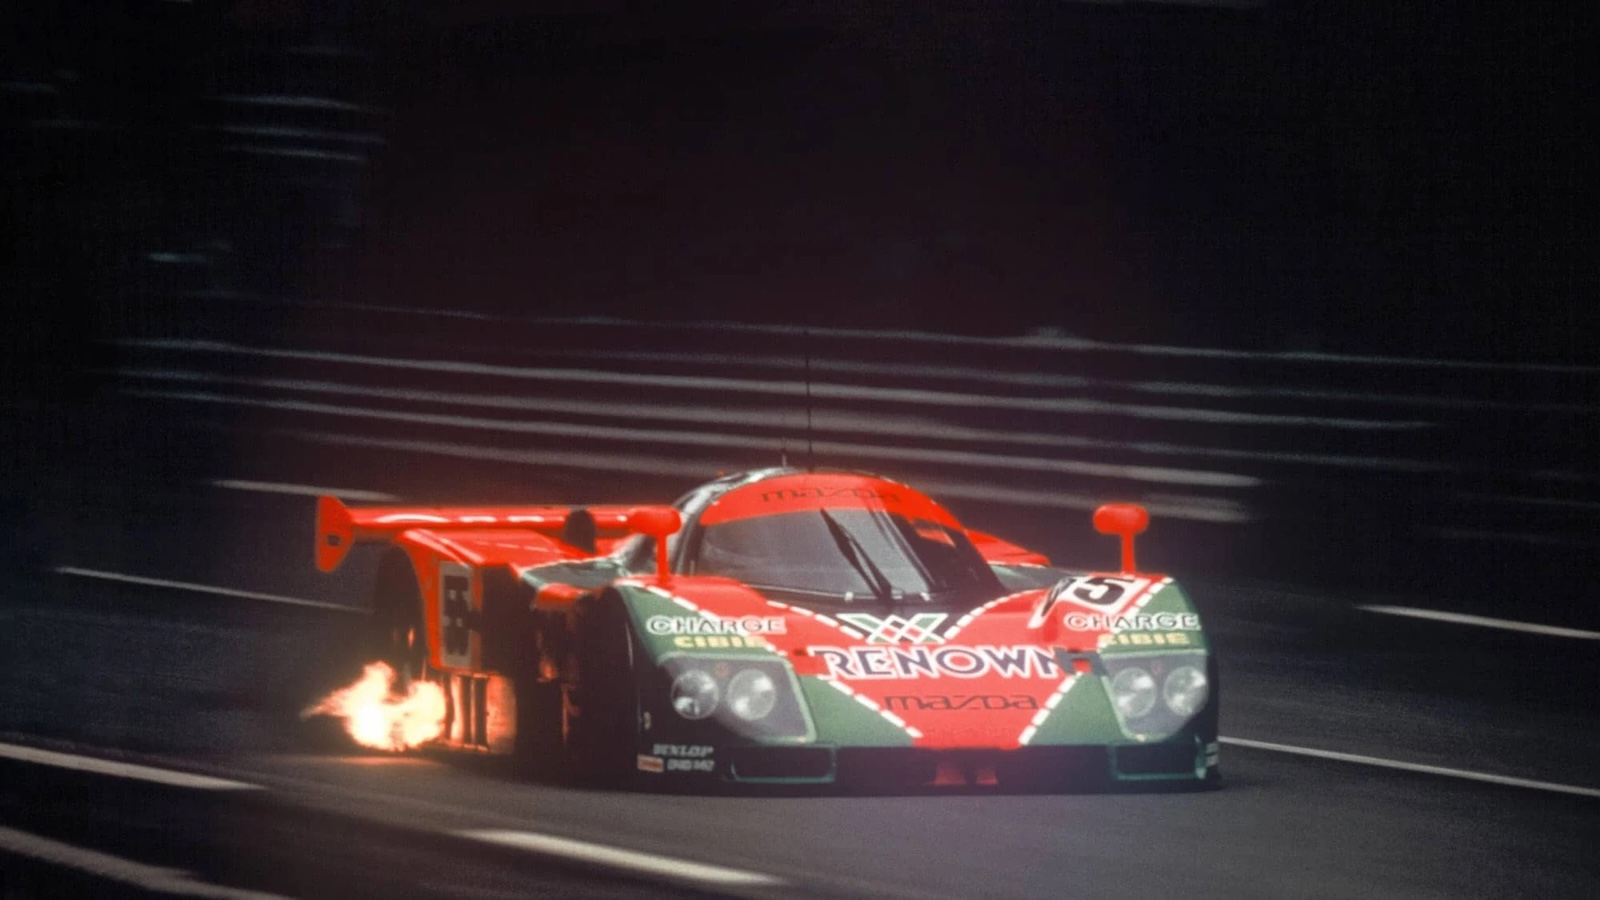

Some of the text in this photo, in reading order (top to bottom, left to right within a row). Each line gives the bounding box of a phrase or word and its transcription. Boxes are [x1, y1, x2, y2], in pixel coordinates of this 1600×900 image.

[646, 615, 787, 635] CHARGE
[1064, 612, 1201, 631] CHARGE
[885, 695, 1039, 710] mazda
